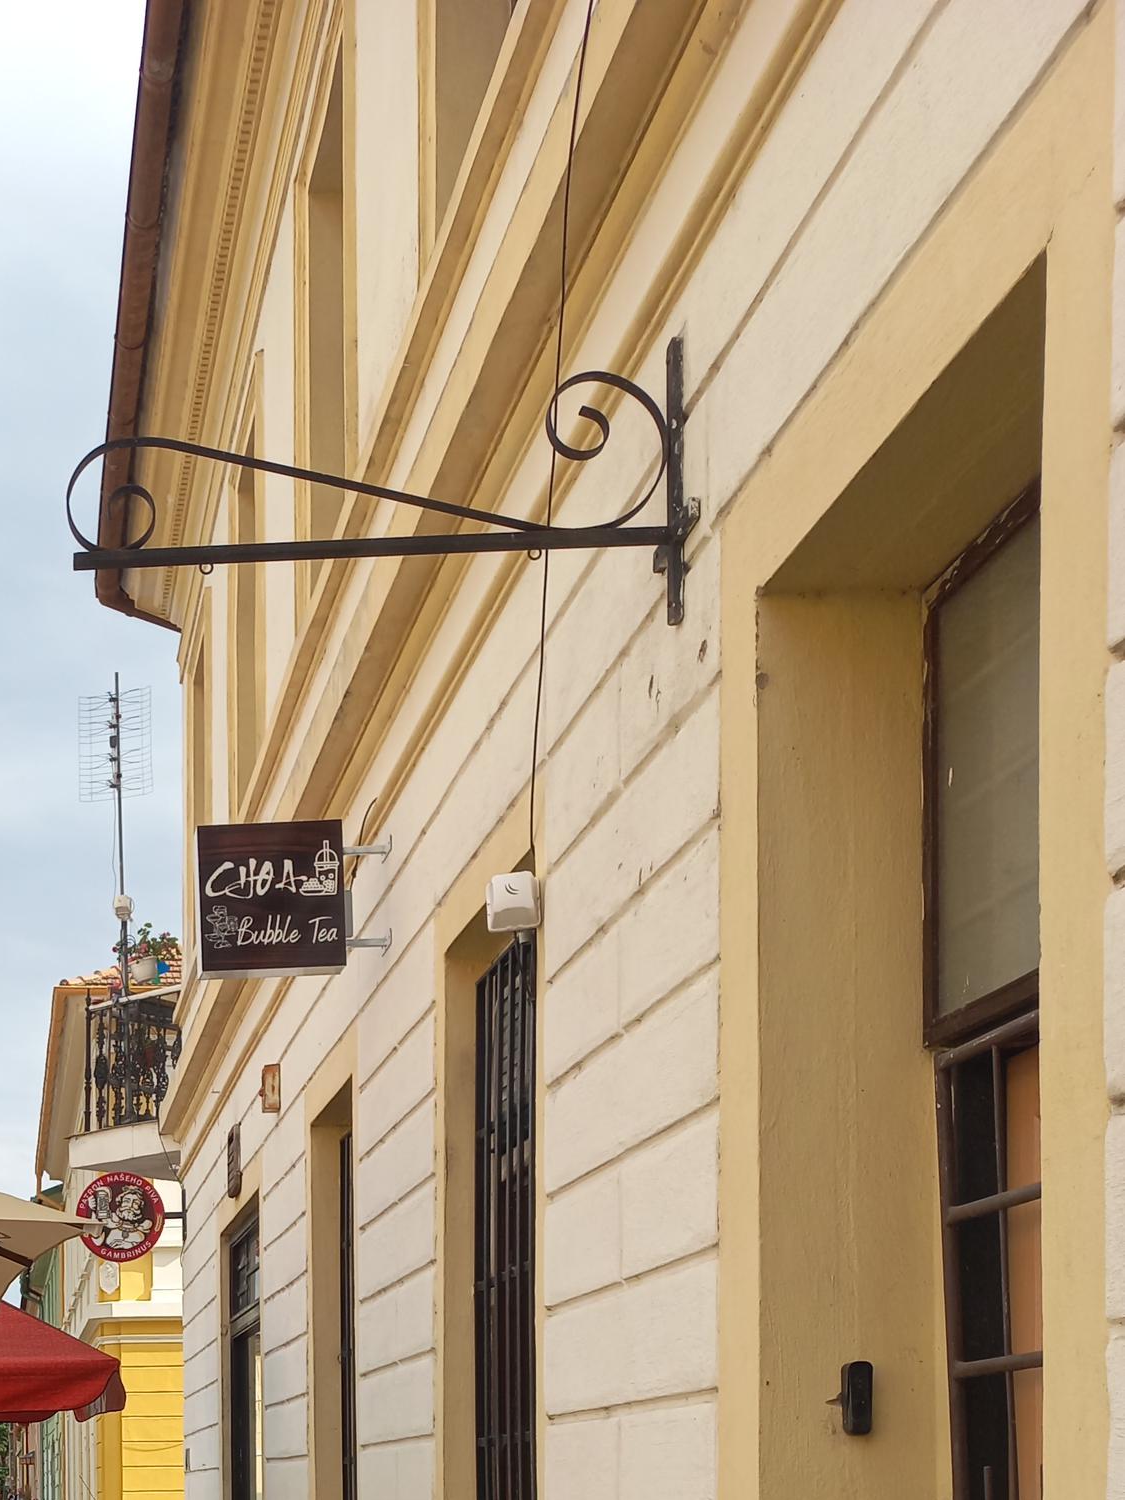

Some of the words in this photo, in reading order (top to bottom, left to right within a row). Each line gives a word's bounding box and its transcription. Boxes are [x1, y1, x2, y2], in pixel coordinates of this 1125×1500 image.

[205, 858, 308, 899] CHOA
[237, 914, 301, 946] Bubble
[308, 916, 338, 944] Tea
[79, 1180, 104, 1209] PATRON
[106, 1173, 142, 1185] NAŠEHO
[144, 1185, 159, 1204] PIVA
[100, 1241, 152, 1259] GAMBRINUS
